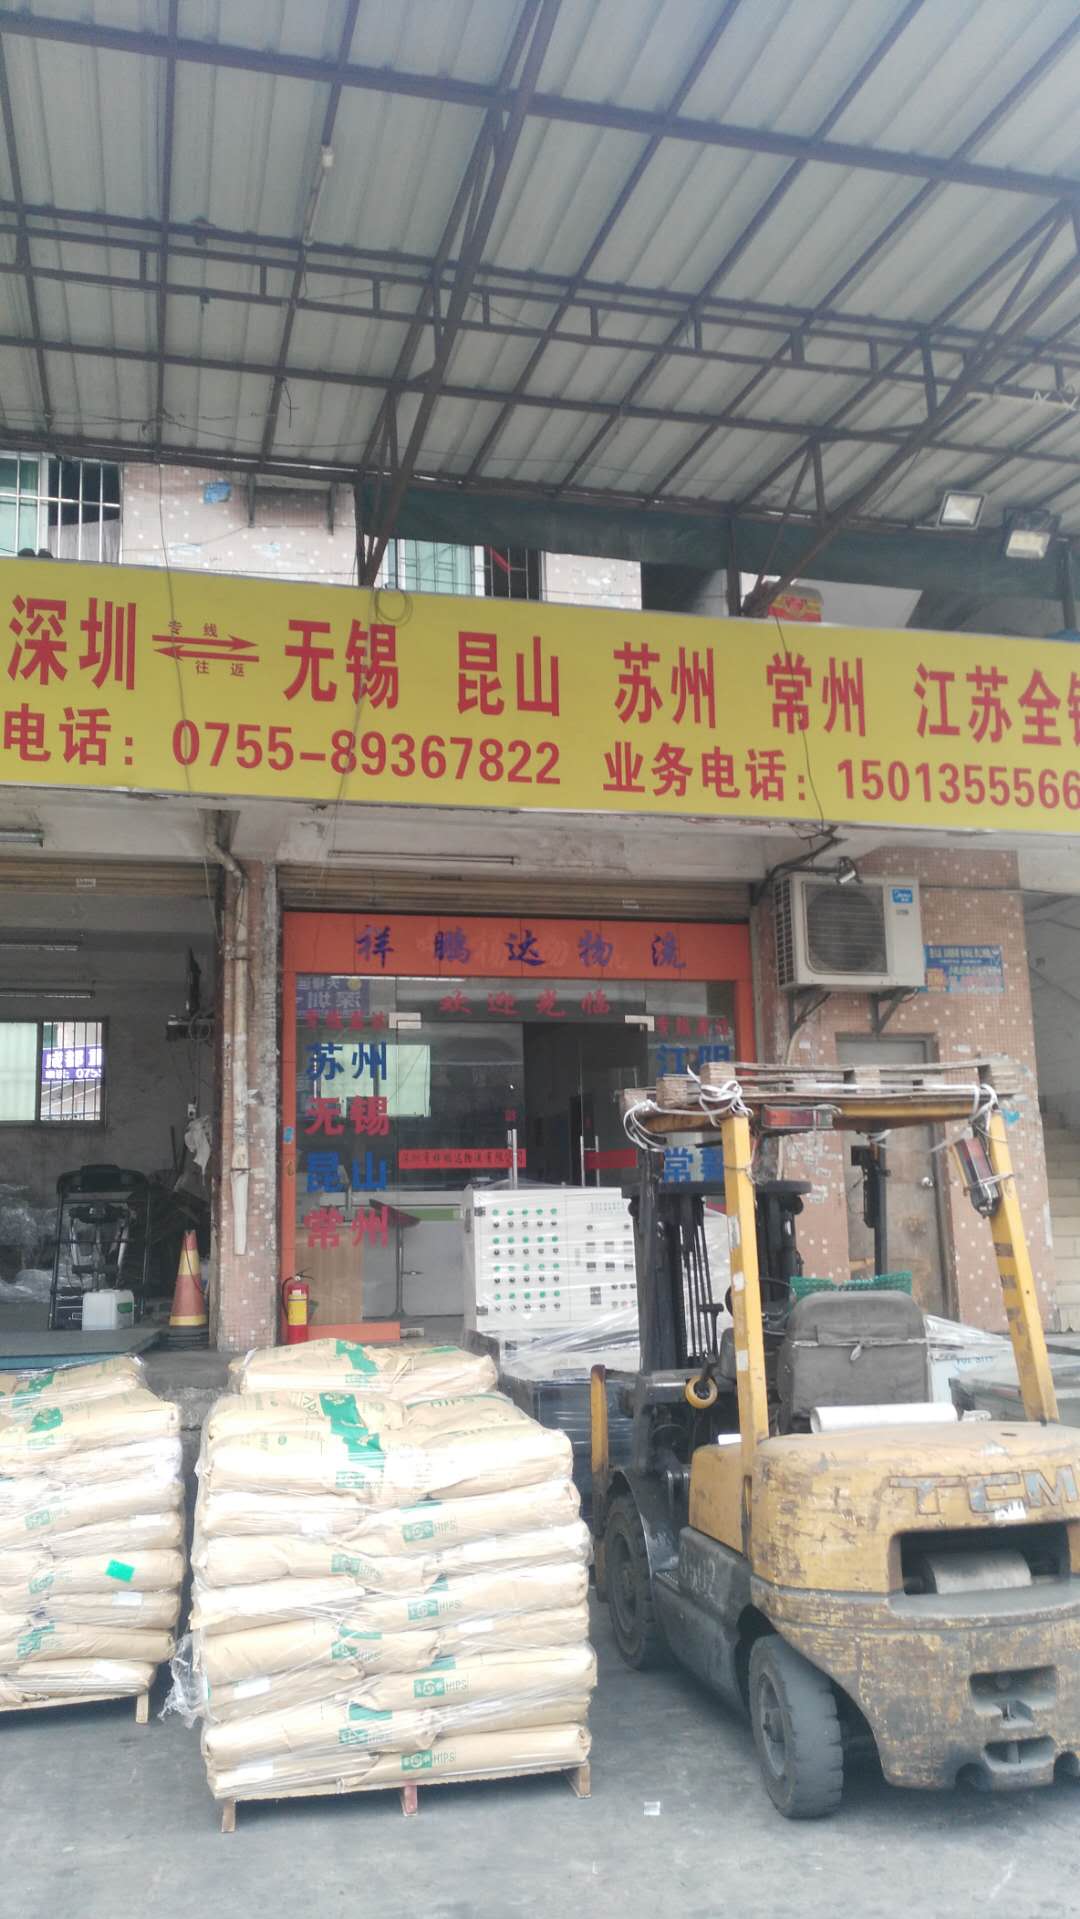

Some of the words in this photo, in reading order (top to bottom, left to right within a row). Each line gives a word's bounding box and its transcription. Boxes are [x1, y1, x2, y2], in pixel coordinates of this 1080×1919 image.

[168, 620, 218, 638] 专线
[8, 594, 137, 690] 深圳
[283, 618, 400, 709] 无锡
[456, 631, 560, 717] 昆山
[613, 641, 716, 729] 苏州
[766, 652, 867, 737] 常州
[195, 660, 245, 677] 往返
[172, 719, 560, 785] 0755-89367822
[602, 741, 806, 801] 业务电话：
[837, 758, 1080, 809] 1501355566
[439, 987, 613, 1017] 欢迎光临
[305, 1041, 388, 1081] 苏州
[304, 1096, 390, 1136] 无锡
[306, 1151, 388, 1193] 昆山
[304, 1205, 389, 1249] 常州
[888, 1464, 1080, 1516] TCM
